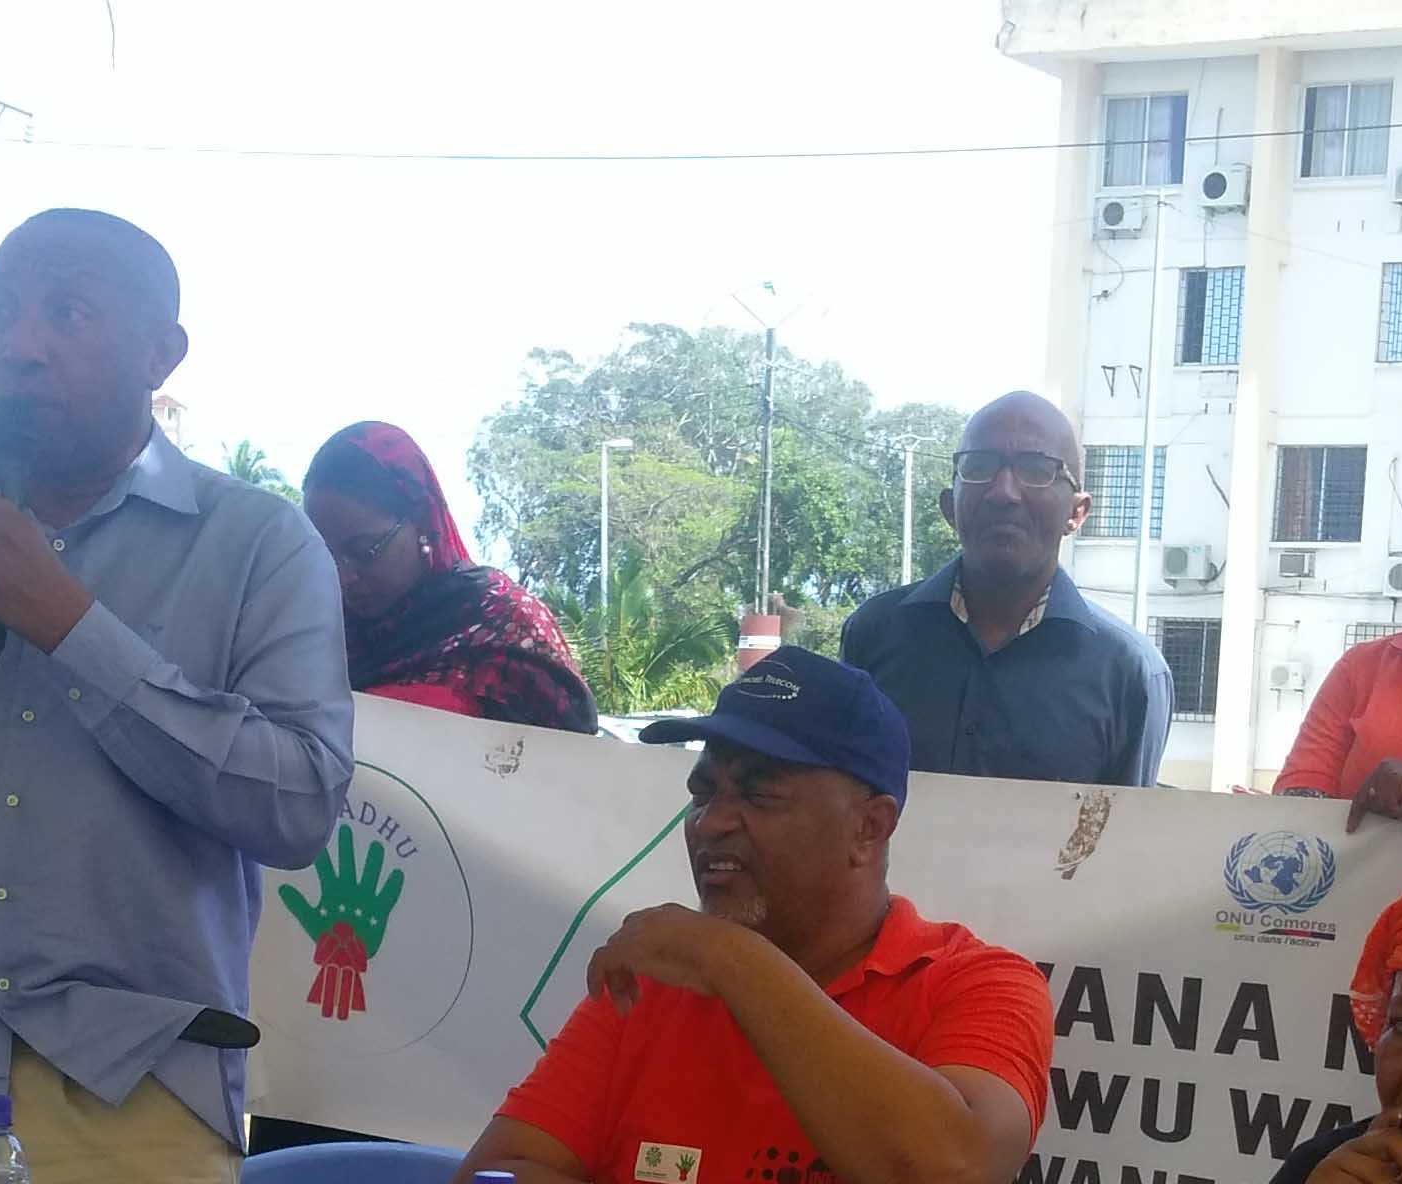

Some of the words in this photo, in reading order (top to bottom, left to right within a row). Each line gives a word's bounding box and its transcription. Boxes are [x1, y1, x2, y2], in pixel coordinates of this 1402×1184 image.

[1215, 910, 1255, 926] ONU
[1260, 914, 1337, 932] Comores
[1257, 934, 1283, 945] dans
[1036, 961, 1280, 1062] ANA
